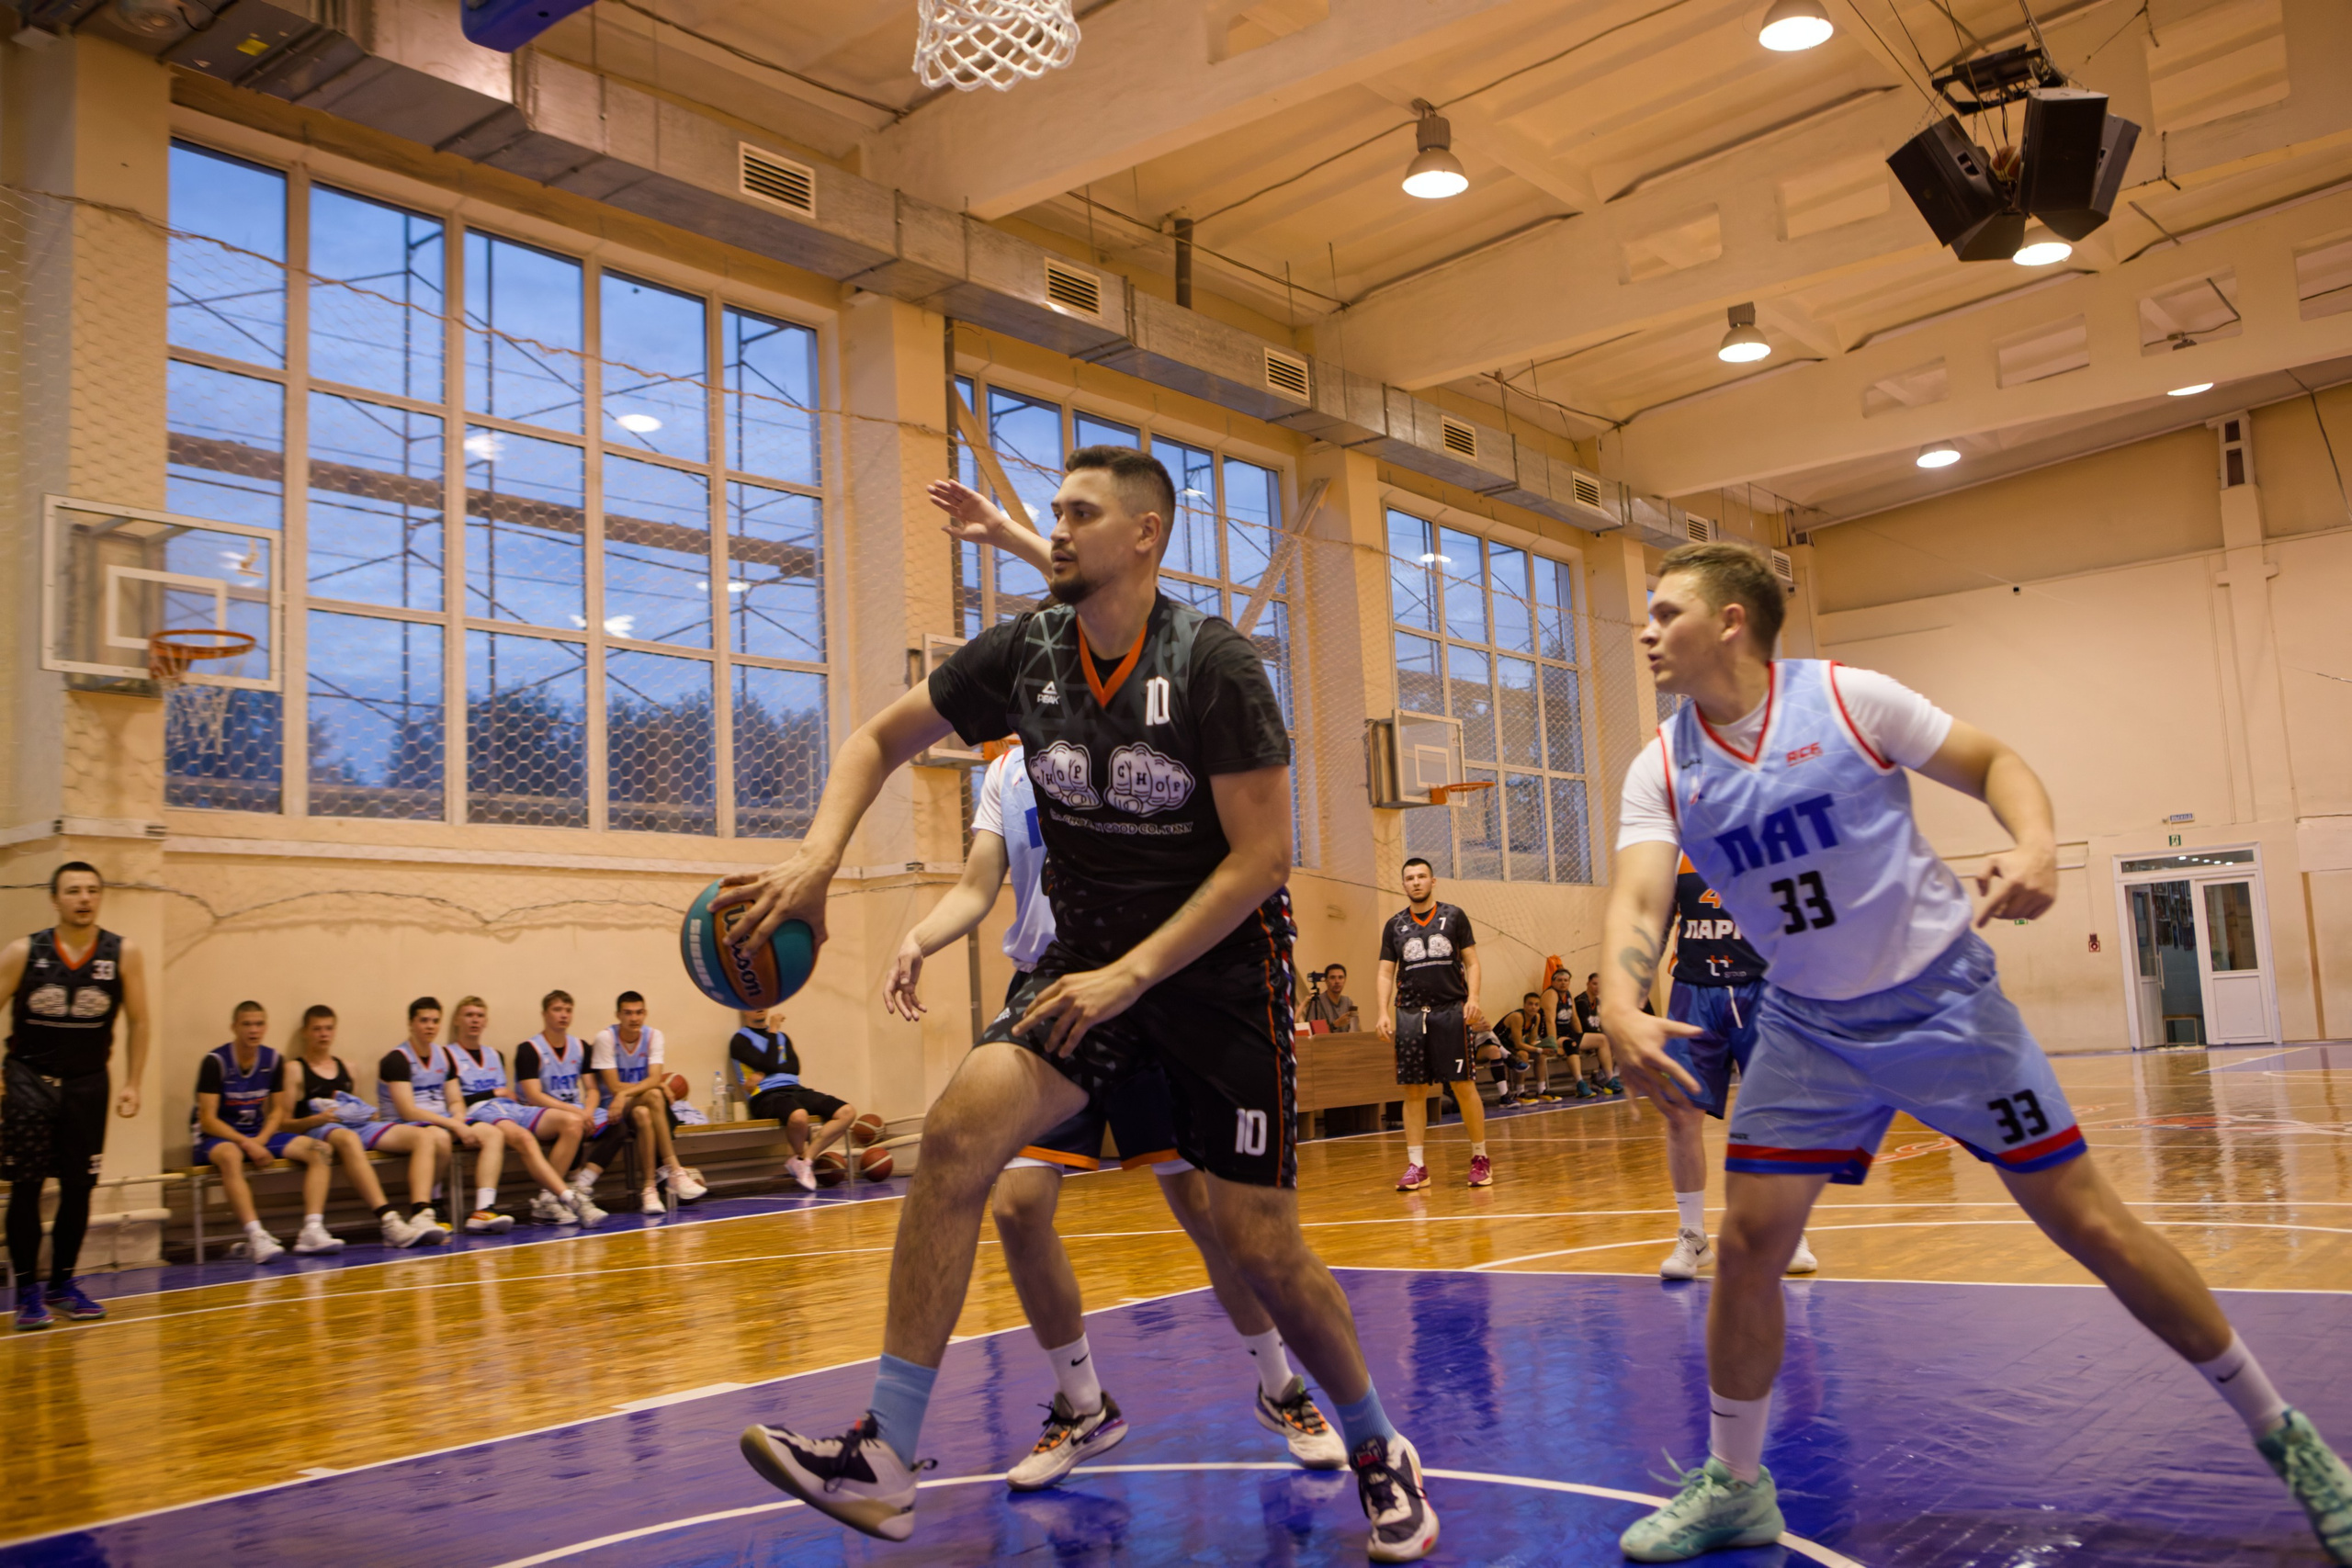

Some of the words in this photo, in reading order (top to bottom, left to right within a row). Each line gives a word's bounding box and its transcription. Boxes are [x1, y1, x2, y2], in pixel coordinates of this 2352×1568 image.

[1037, 694, 1060, 705] PEAK
[1146, 676, 1170, 726] 10
[1117, 765, 1182, 793] CHOP
[1699, 888, 1721, 908] 4
[1770, 870, 1837, 934] 33
[1439, 917, 1446, 931] 7
[1455, 1059, 1464, 1073] 7
[1987, 1089, 2050, 1145] 33
[1236, 1108, 1267, 1156] 10
